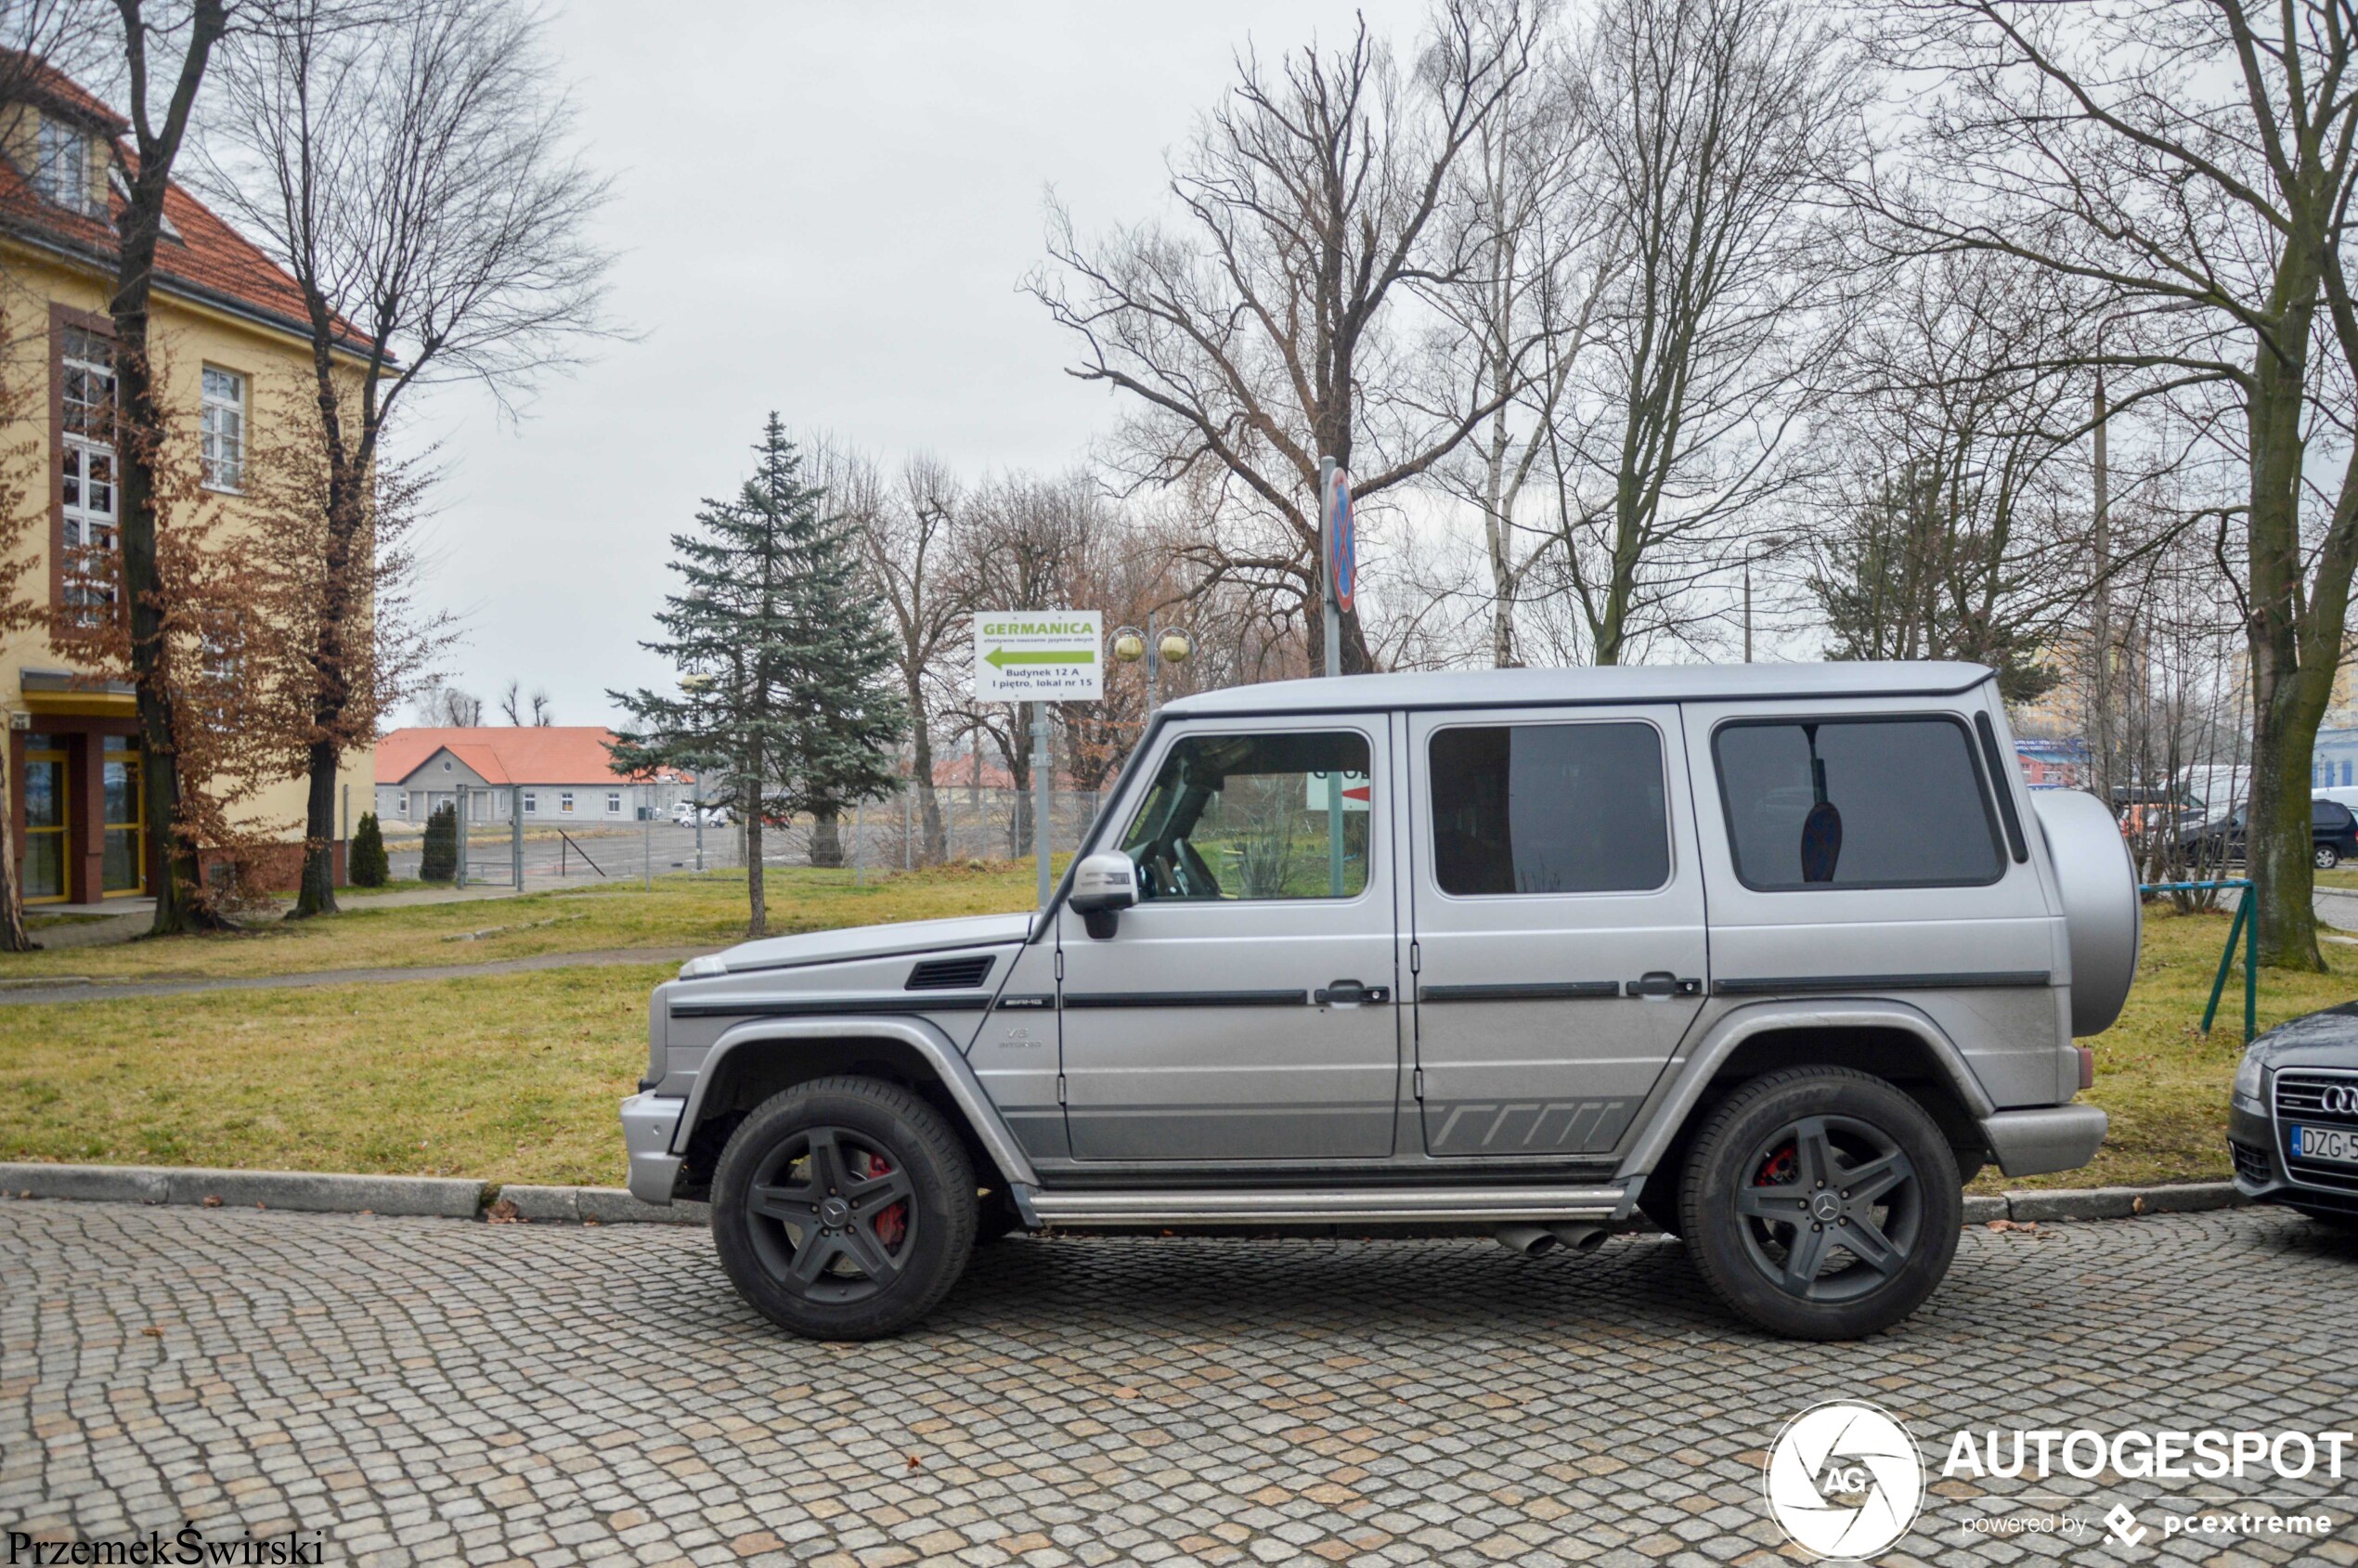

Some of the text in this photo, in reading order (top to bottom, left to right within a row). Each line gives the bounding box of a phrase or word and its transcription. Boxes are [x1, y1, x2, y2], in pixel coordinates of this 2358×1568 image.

[983, 623, 1094, 635] GERMANICA
[1006, 668, 1051, 678] Budynek
[1000, 680, 1032, 690] piętro,
[1037, 679, 1061, 687] lokal
[2303, 1129, 2341, 1158] DZG
